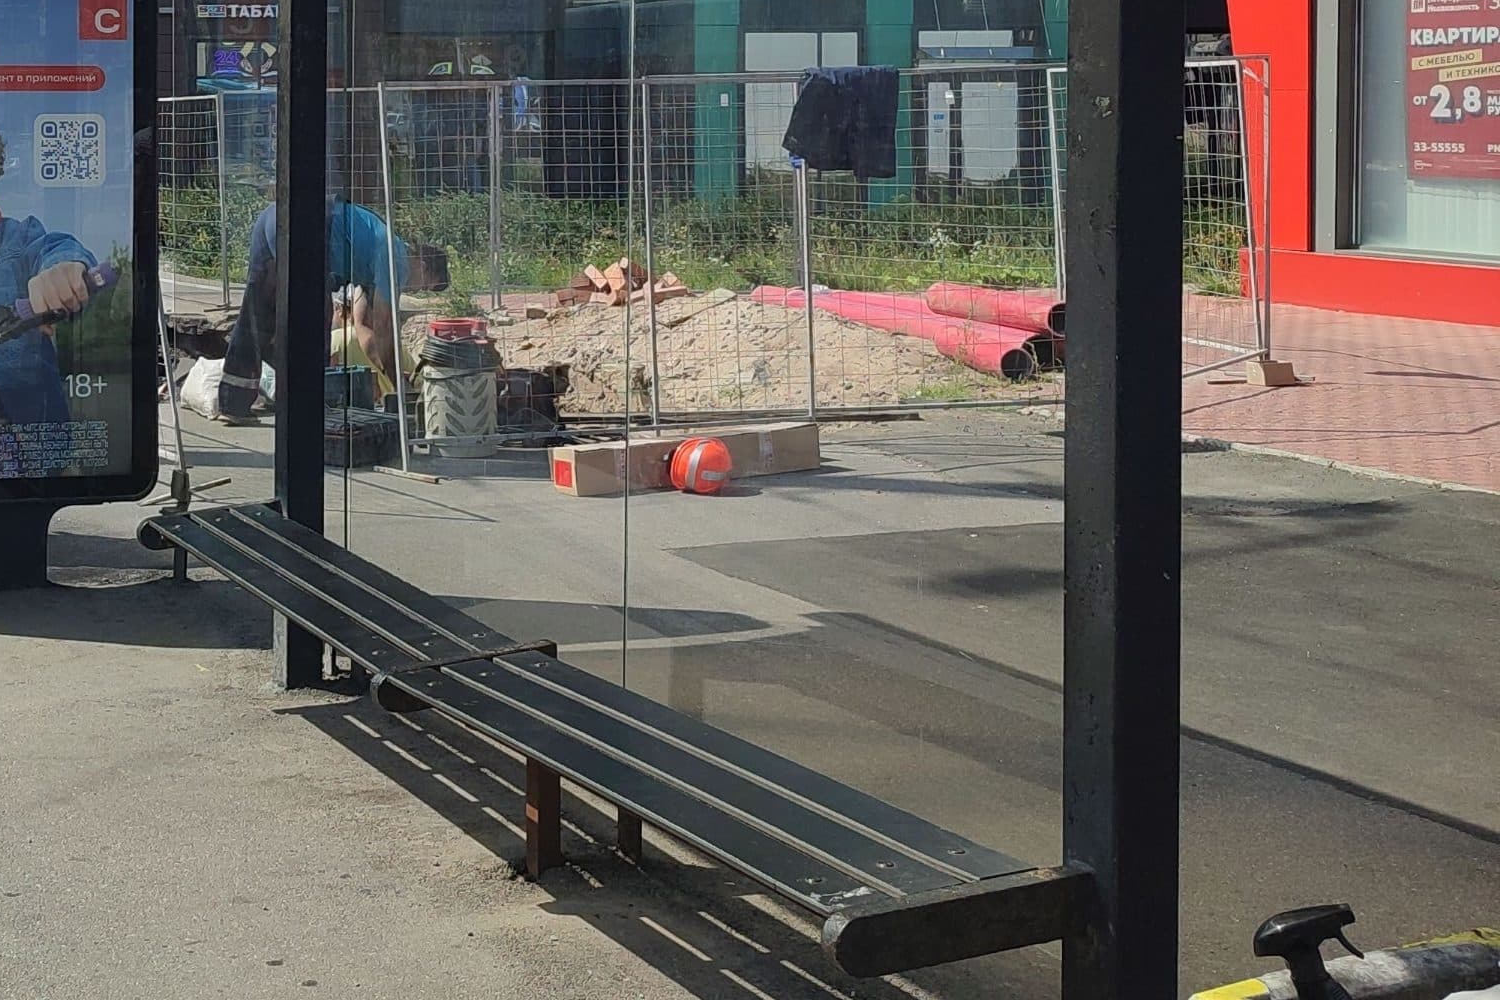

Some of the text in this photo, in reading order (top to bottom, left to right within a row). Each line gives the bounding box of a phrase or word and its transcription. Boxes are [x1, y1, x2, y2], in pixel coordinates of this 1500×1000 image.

[1410, 26, 1500, 46] КВАРТИР
[1426, 52, 1476, 66] МЕБЕЛЬЮ
[1429, 84, 1482, 120] 2,8
[1413, 141, 1466, 153] 33-55555
[64, 373, 108, 399] 18+
